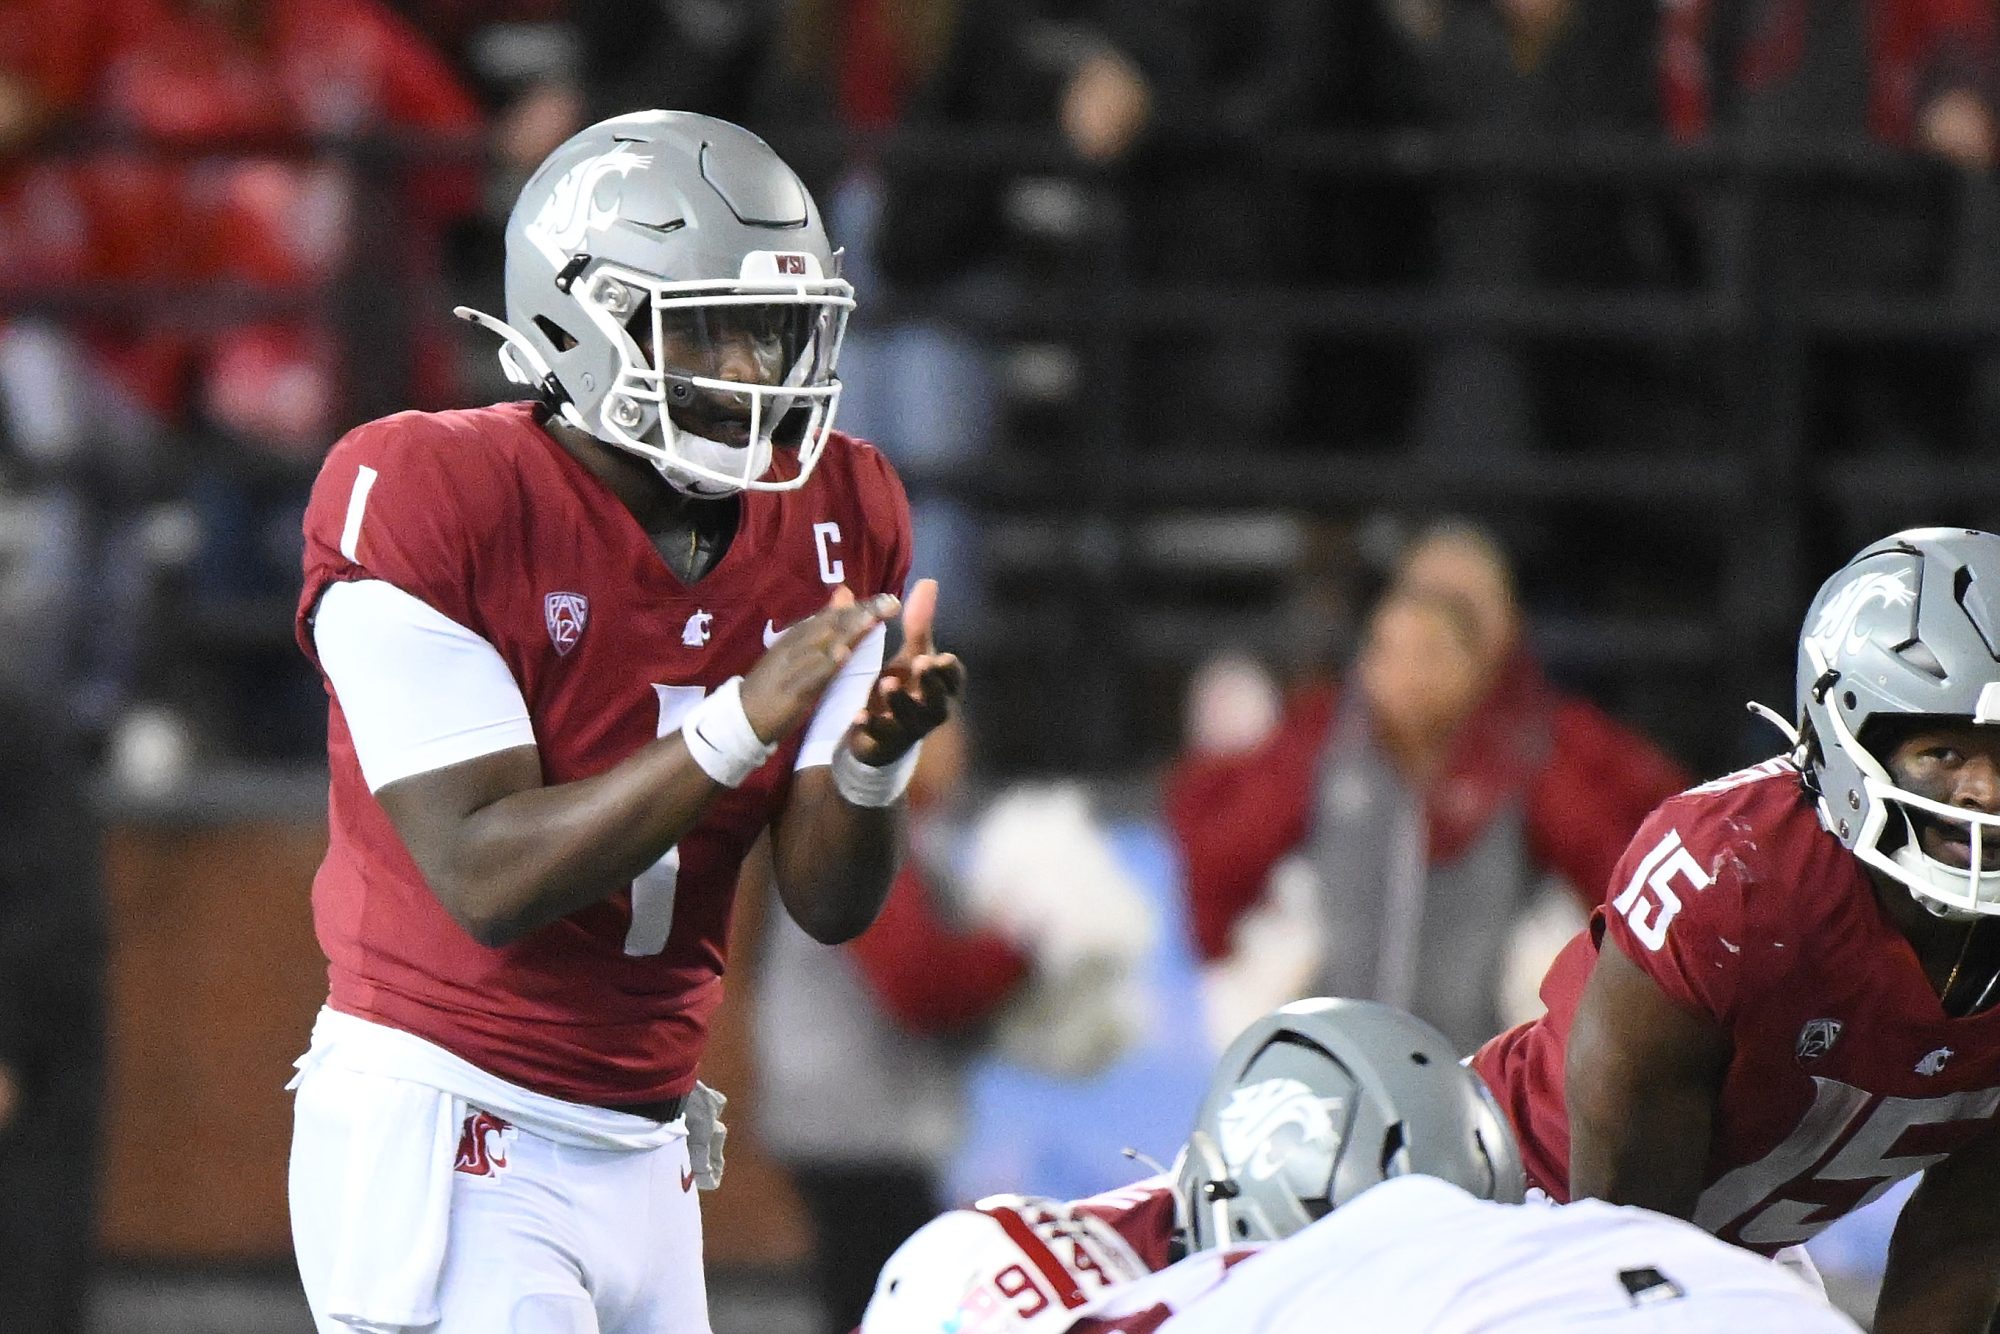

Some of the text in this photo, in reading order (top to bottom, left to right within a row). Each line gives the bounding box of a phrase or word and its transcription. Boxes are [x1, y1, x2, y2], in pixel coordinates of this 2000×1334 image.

[775, 254, 806, 275] WSU
[340, 465, 378, 565] 1
[813, 521, 844, 584] C
[549, 595, 586, 632] PAC
[556, 619, 574, 641] 12
[1613, 827, 1710, 952] 15
[994, 1263, 1050, 1319] 9
